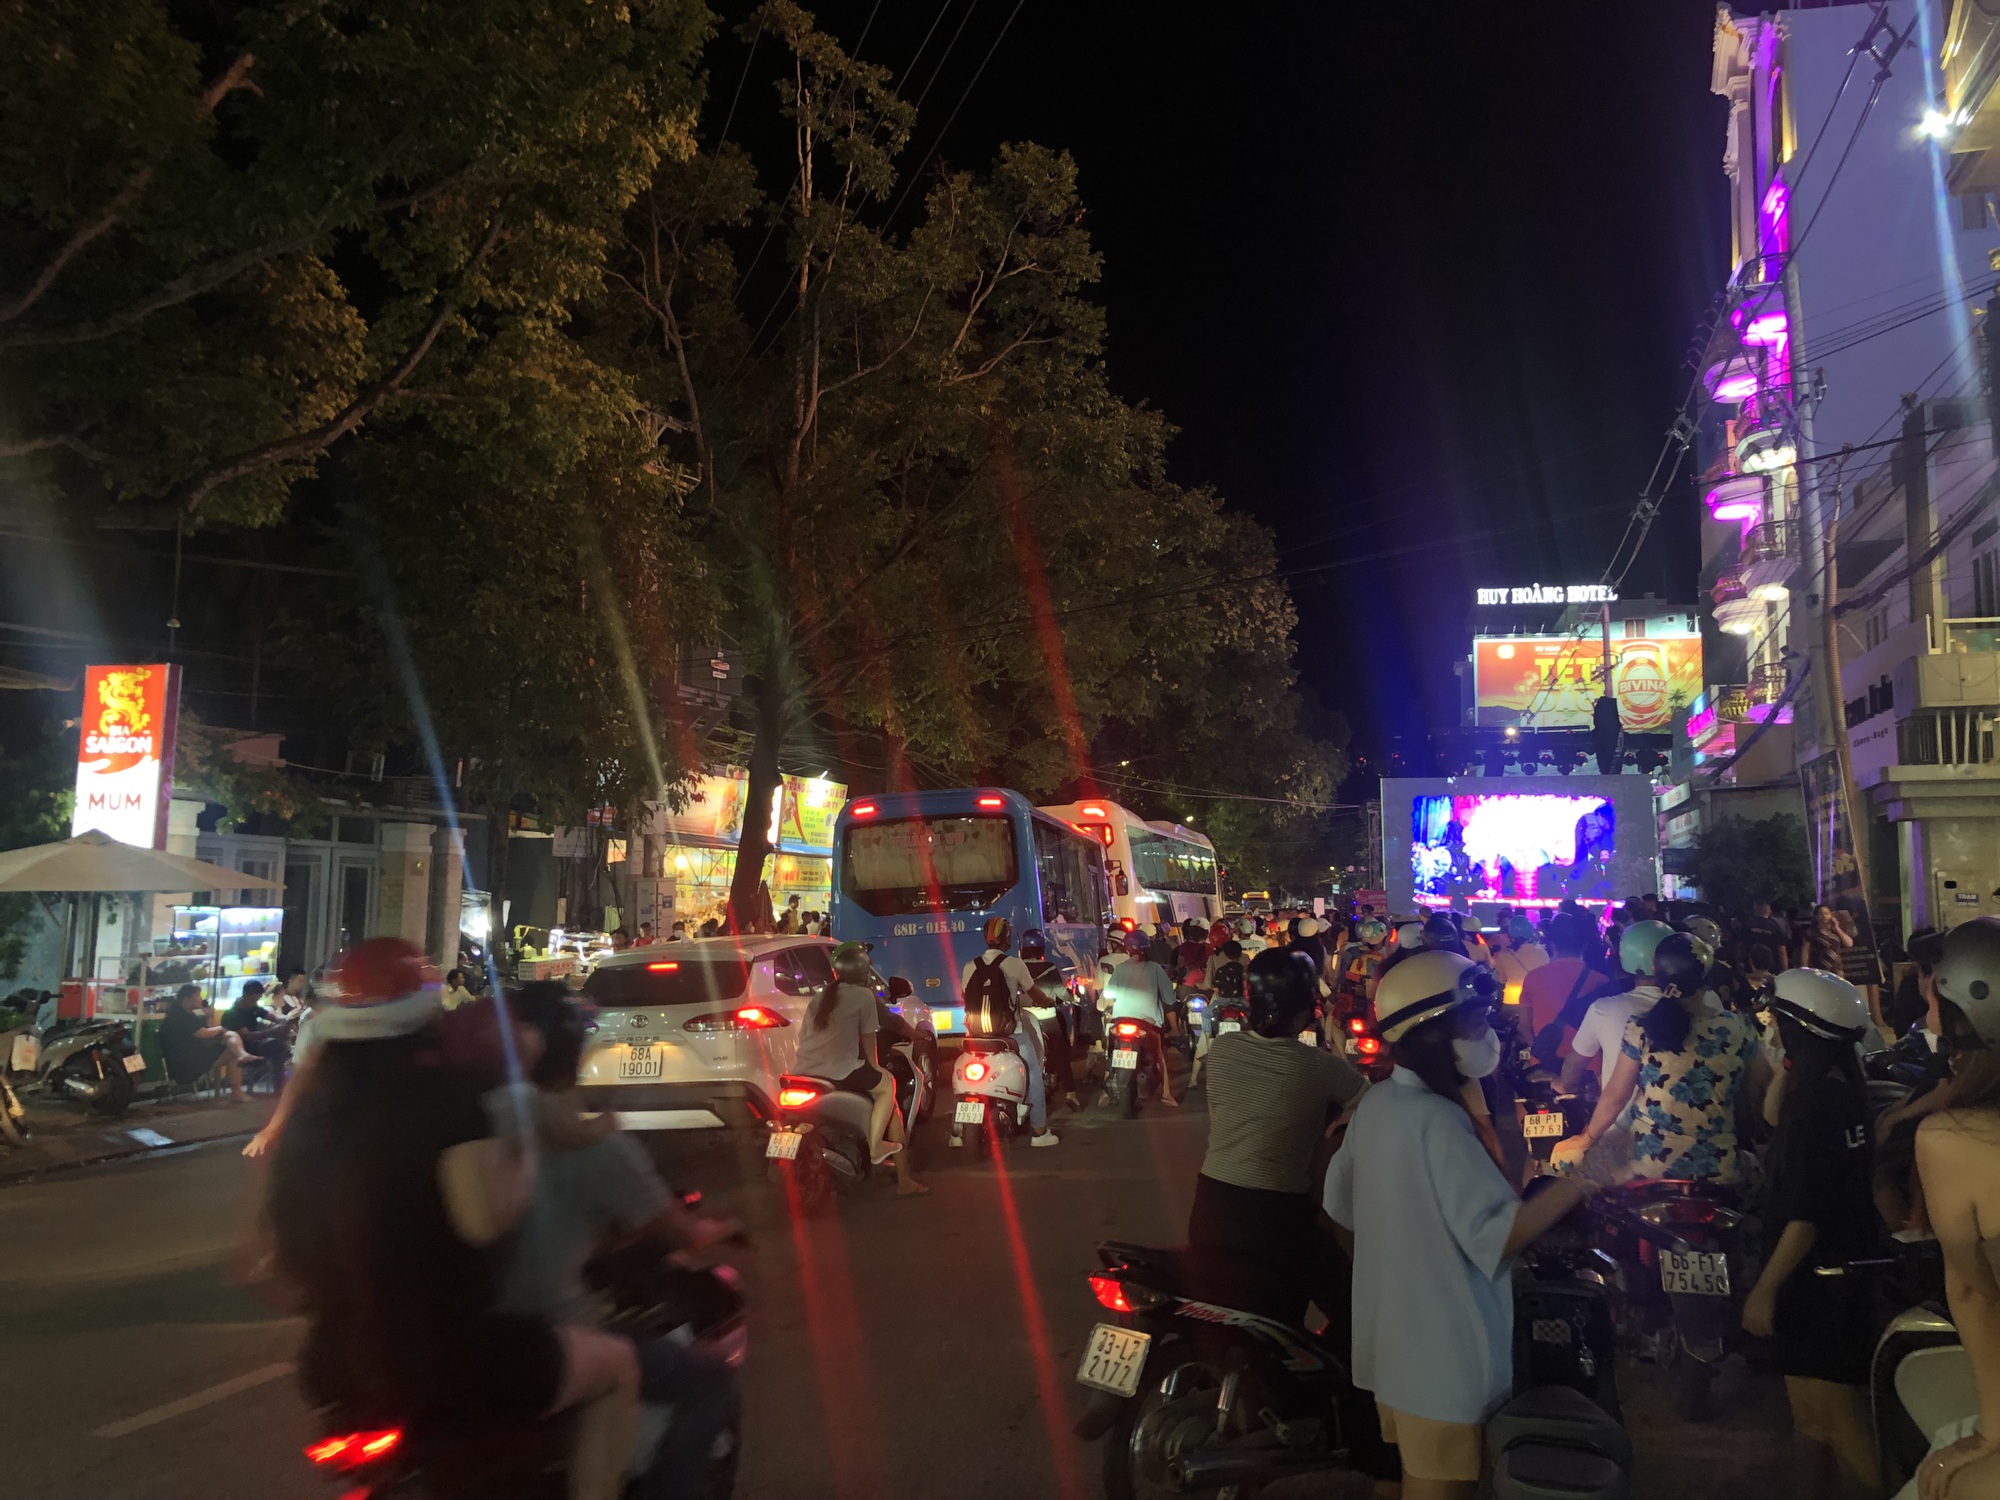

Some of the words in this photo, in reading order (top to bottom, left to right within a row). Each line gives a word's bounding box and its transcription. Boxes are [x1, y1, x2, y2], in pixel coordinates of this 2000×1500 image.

[1477, 588, 1509, 604] HUY
[1511, 582, 1564, 604] HOÀNG
[1566, 585, 1618, 602] HOTEL
[1619, 680, 1667, 693] BIVINA
[88, 793, 142, 811] MUM
[631, 1047, 651, 1061] 68A
[622, 1061, 658, 1076] 190.01
